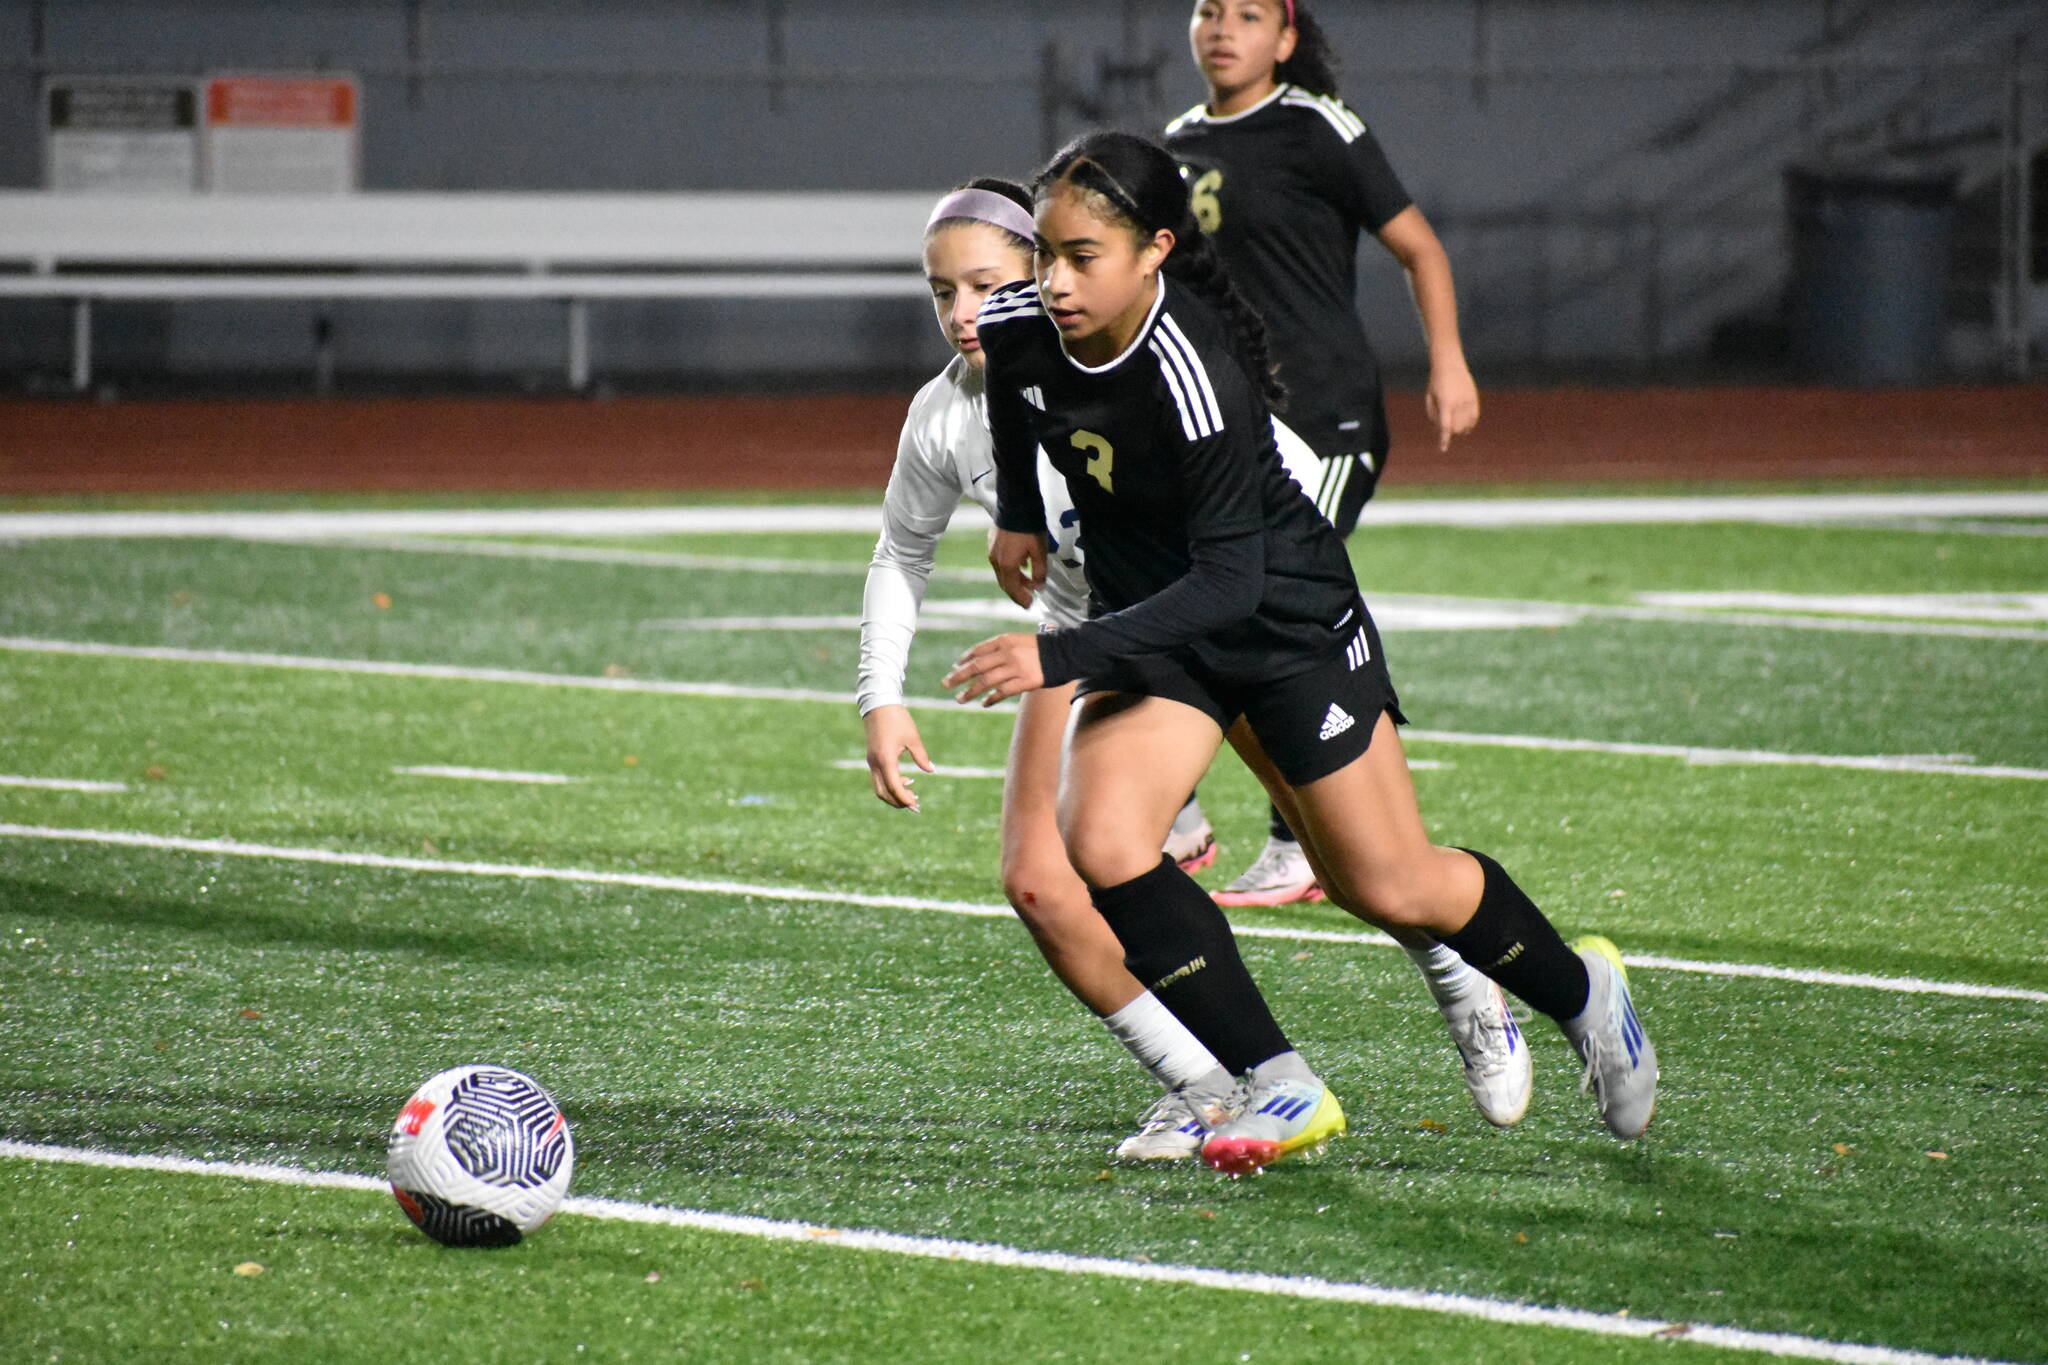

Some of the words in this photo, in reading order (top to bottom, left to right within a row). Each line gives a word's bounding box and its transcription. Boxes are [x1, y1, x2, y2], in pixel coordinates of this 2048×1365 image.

[1191, 168, 1223, 235] 6
[1070, 429, 1114, 495] 3
[1319, 715, 1355, 740] adidas
